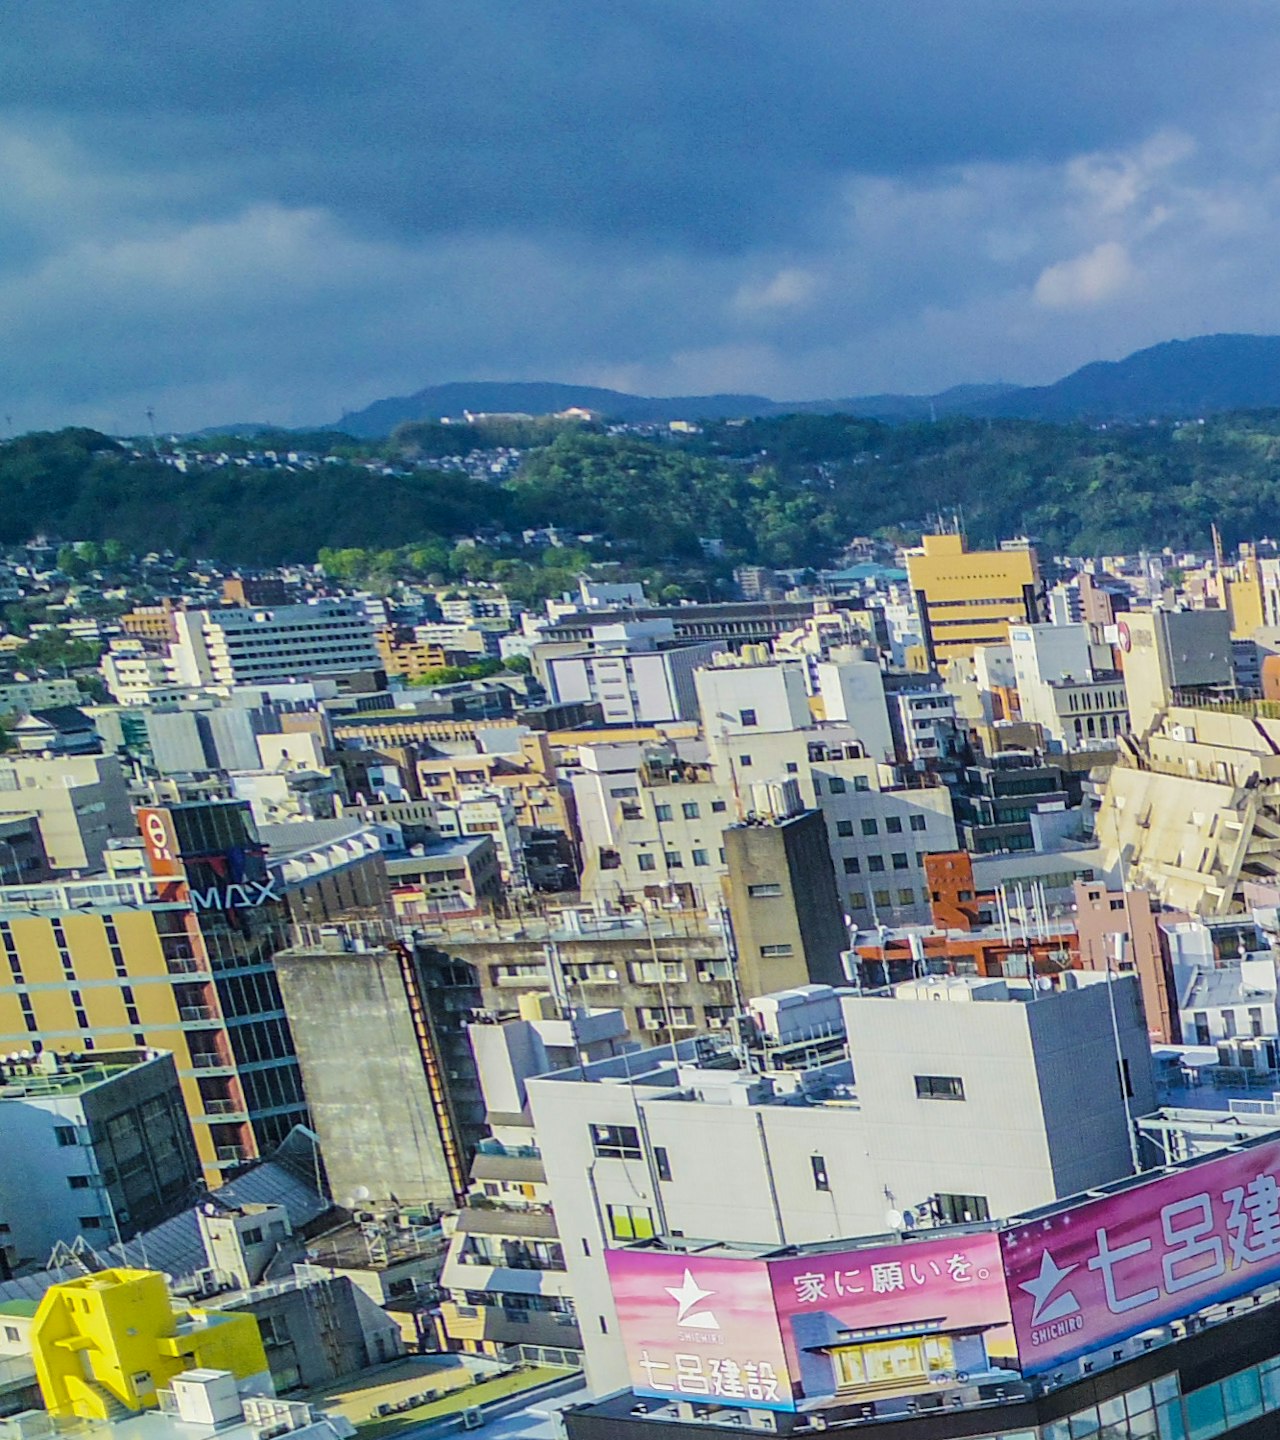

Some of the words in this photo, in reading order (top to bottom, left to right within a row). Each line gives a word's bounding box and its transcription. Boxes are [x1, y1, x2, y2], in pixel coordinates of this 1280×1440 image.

[793, 1253, 990, 1303] 家に願いを。
[1031, 1314, 1084, 1347] SHICHIRO
[639, 1350, 781, 1402] 七呂建設
